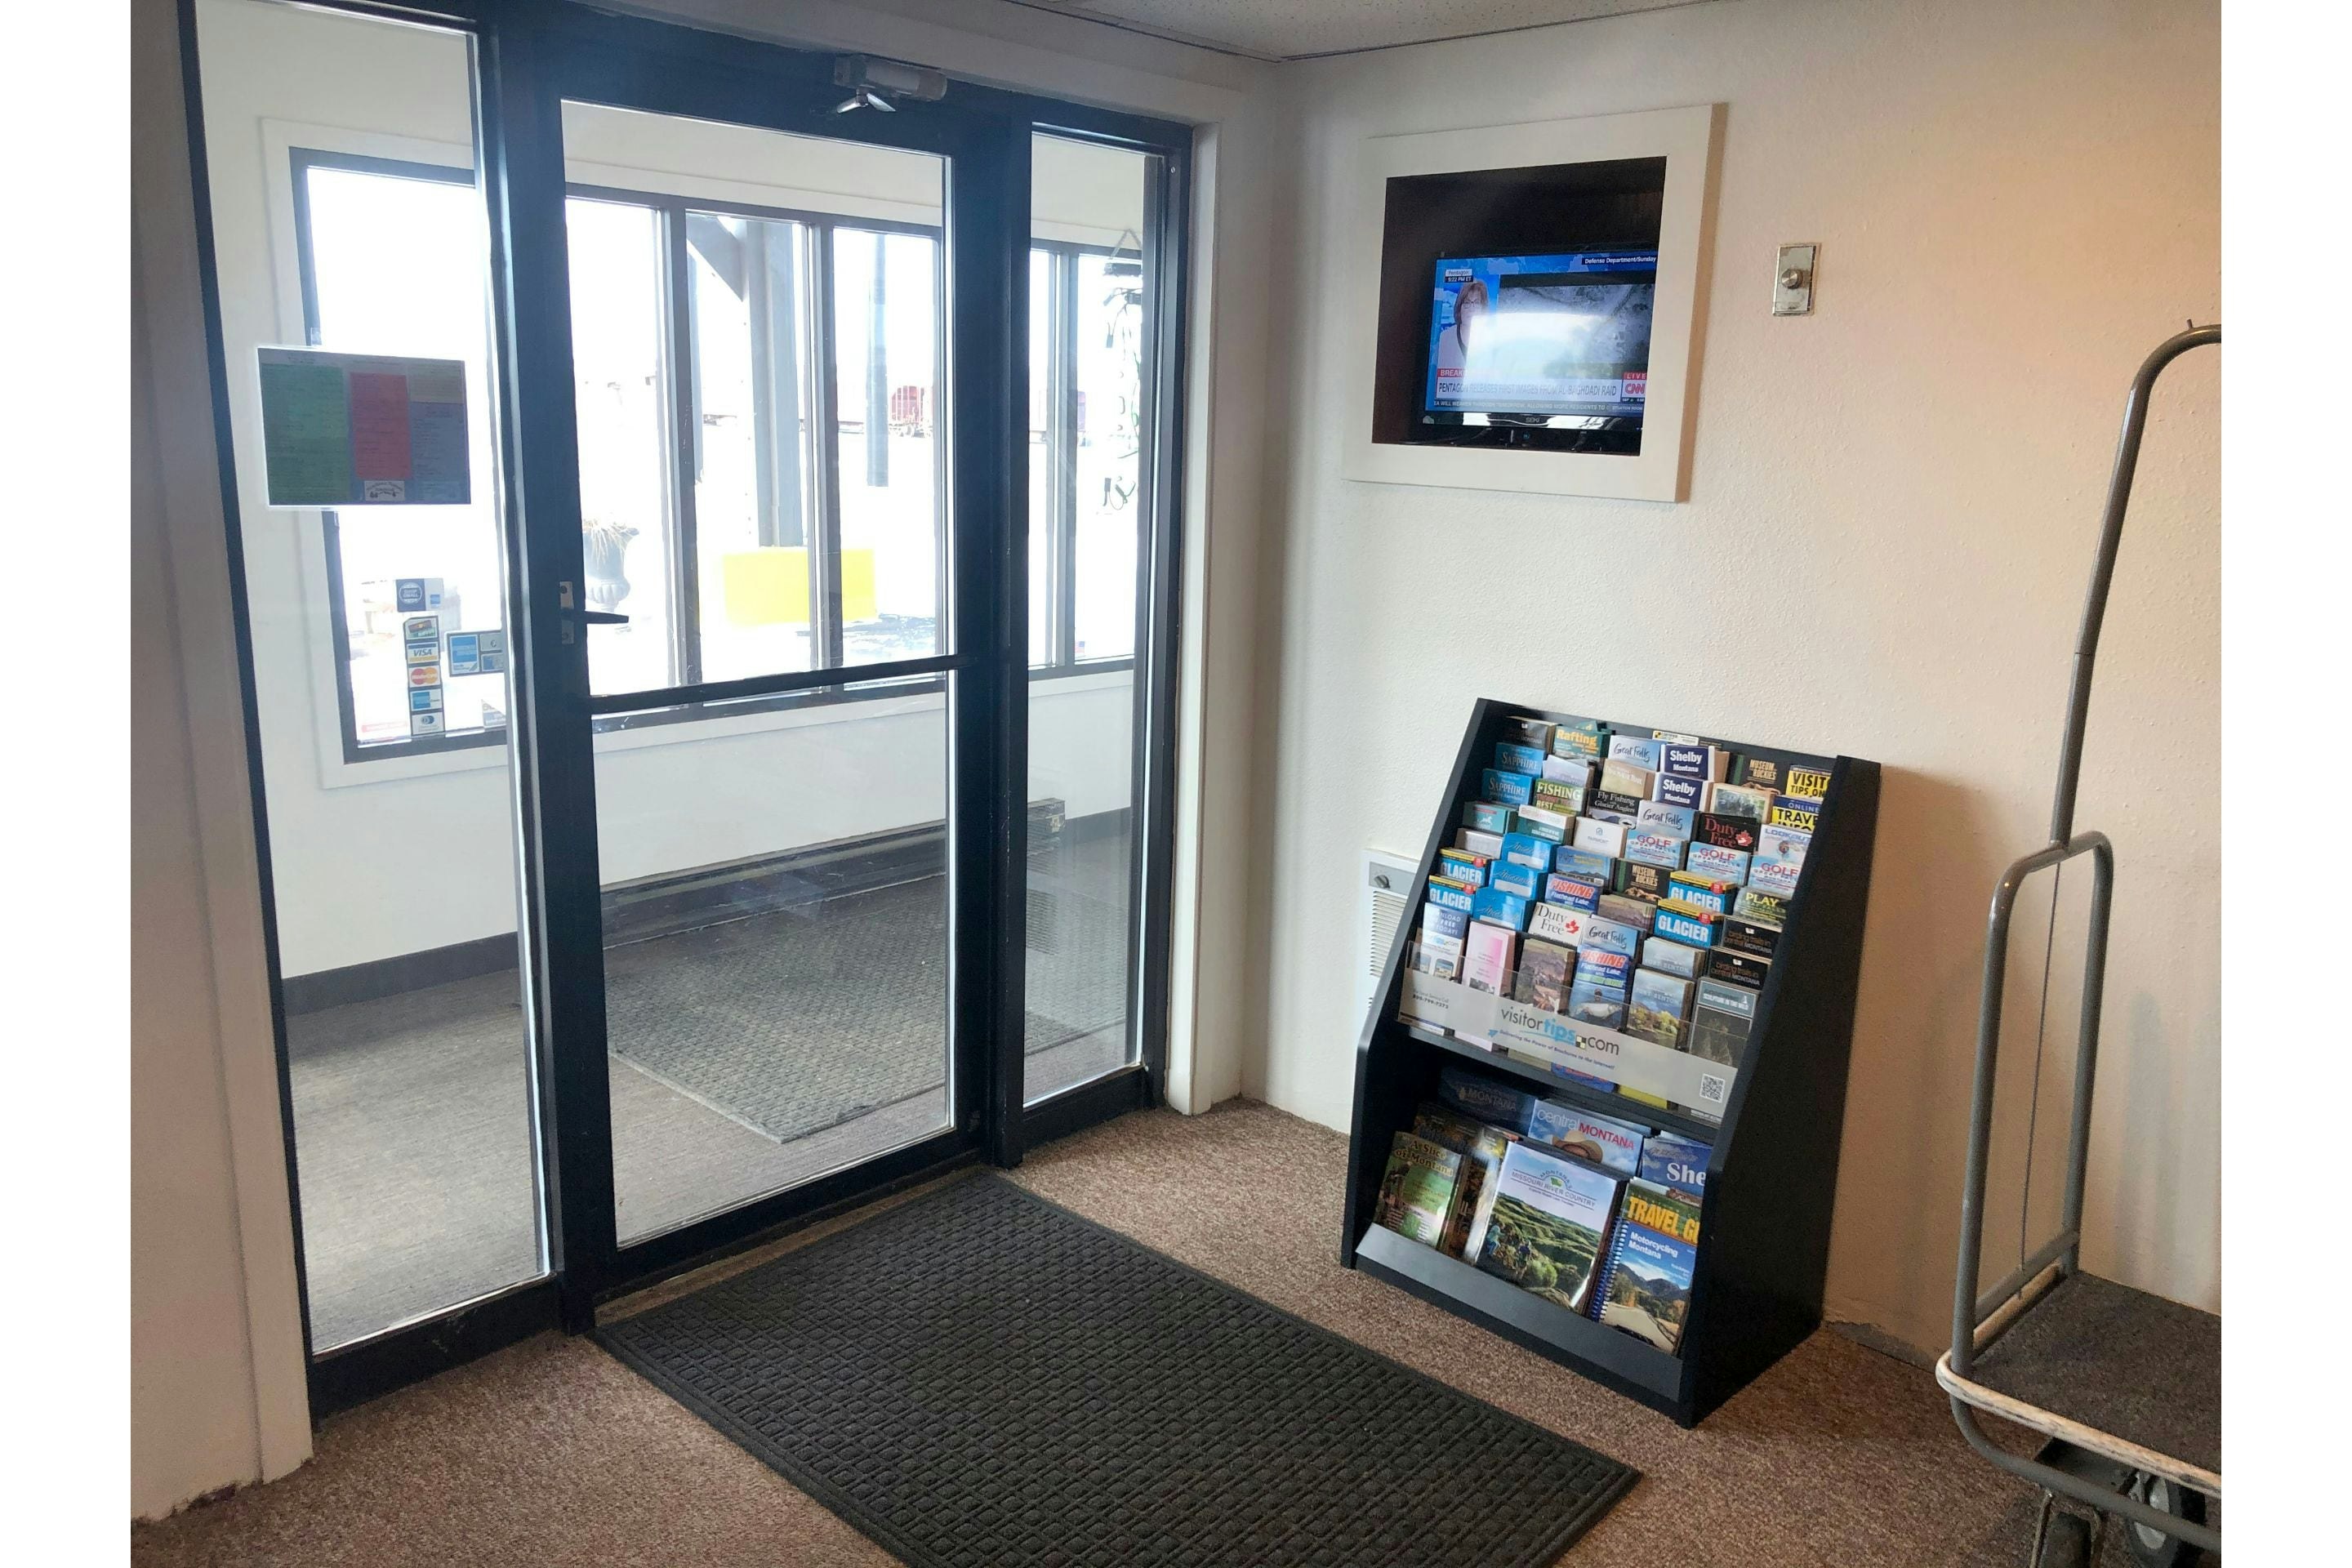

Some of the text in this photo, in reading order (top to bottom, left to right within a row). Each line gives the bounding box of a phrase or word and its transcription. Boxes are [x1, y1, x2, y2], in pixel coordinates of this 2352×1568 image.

[1601, 385, 1617, 396] RAID
[1625, 383, 1646, 394] CNN
[1556, 728, 1597, 747] Rafting
[1614, 742, 1632, 756] Great
[1669, 750, 1703, 764] Shelby
[1673, 764, 1699, 773] Montana
[1663, 778, 1696, 796] Shelby
[1793, 772, 1830, 789] VISIT
[1536, 782, 1582, 801] FISHING
[1597, 791, 1608, 804] Fly
[1610, 794, 1635, 807] Fishing
[1664, 793, 1690, 804] Montana
[1791, 785, 1808, 795] TIPS
[1788, 801, 1820, 813] ONLINE
[1643, 808, 1683, 831] Great Falls
[1705, 817, 1738, 836] Duty
[1637, 835, 1672, 848] GOLF
[1709, 831, 1736, 849] Free
[1699, 848, 1736, 862] GOLF
[1441, 862, 1482, 884] GLACIER
[1761, 862, 1798, 876] GOLF
[1548, 878, 1595, 899] FISHING
[1429, 888, 1472, 911] GLACIER
[1575, 897, 1589, 906] Lake
[1670, 887, 1722, 912] GLACIER
[1746, 893, 1780, 908] PLAY
[1537, 904, 1567, 923] Duty
[1540, 919, 1565, 936] Free
[1658, 915, 1708, 942] GLACIER
[1588, 925, 1628, 949] Great Falls
[1580, 950, 1627, 969] FISHING
[1606, 968, 1621, 976] Lake
[1531, 1039, 1547, 1049] Power
[1536, 1107, 1636, 1151] central MONTANA
[1410, 1139, 1448, 1161] A Slice
[1395, 1147, 1454, 1178] of Montana
[1512, 1170, 1544, 1188] MISSOURI
[1544, 1183, 1563, 1196] RIVER
[1565, 1191, 1596, 1207] COUNTRY
[1627, 1196, 1681, 1236] TRAVEL
[1628, 1240, 1662, 1260] Montana
[1630, 1231, 1678, 1259] Motorcycling
